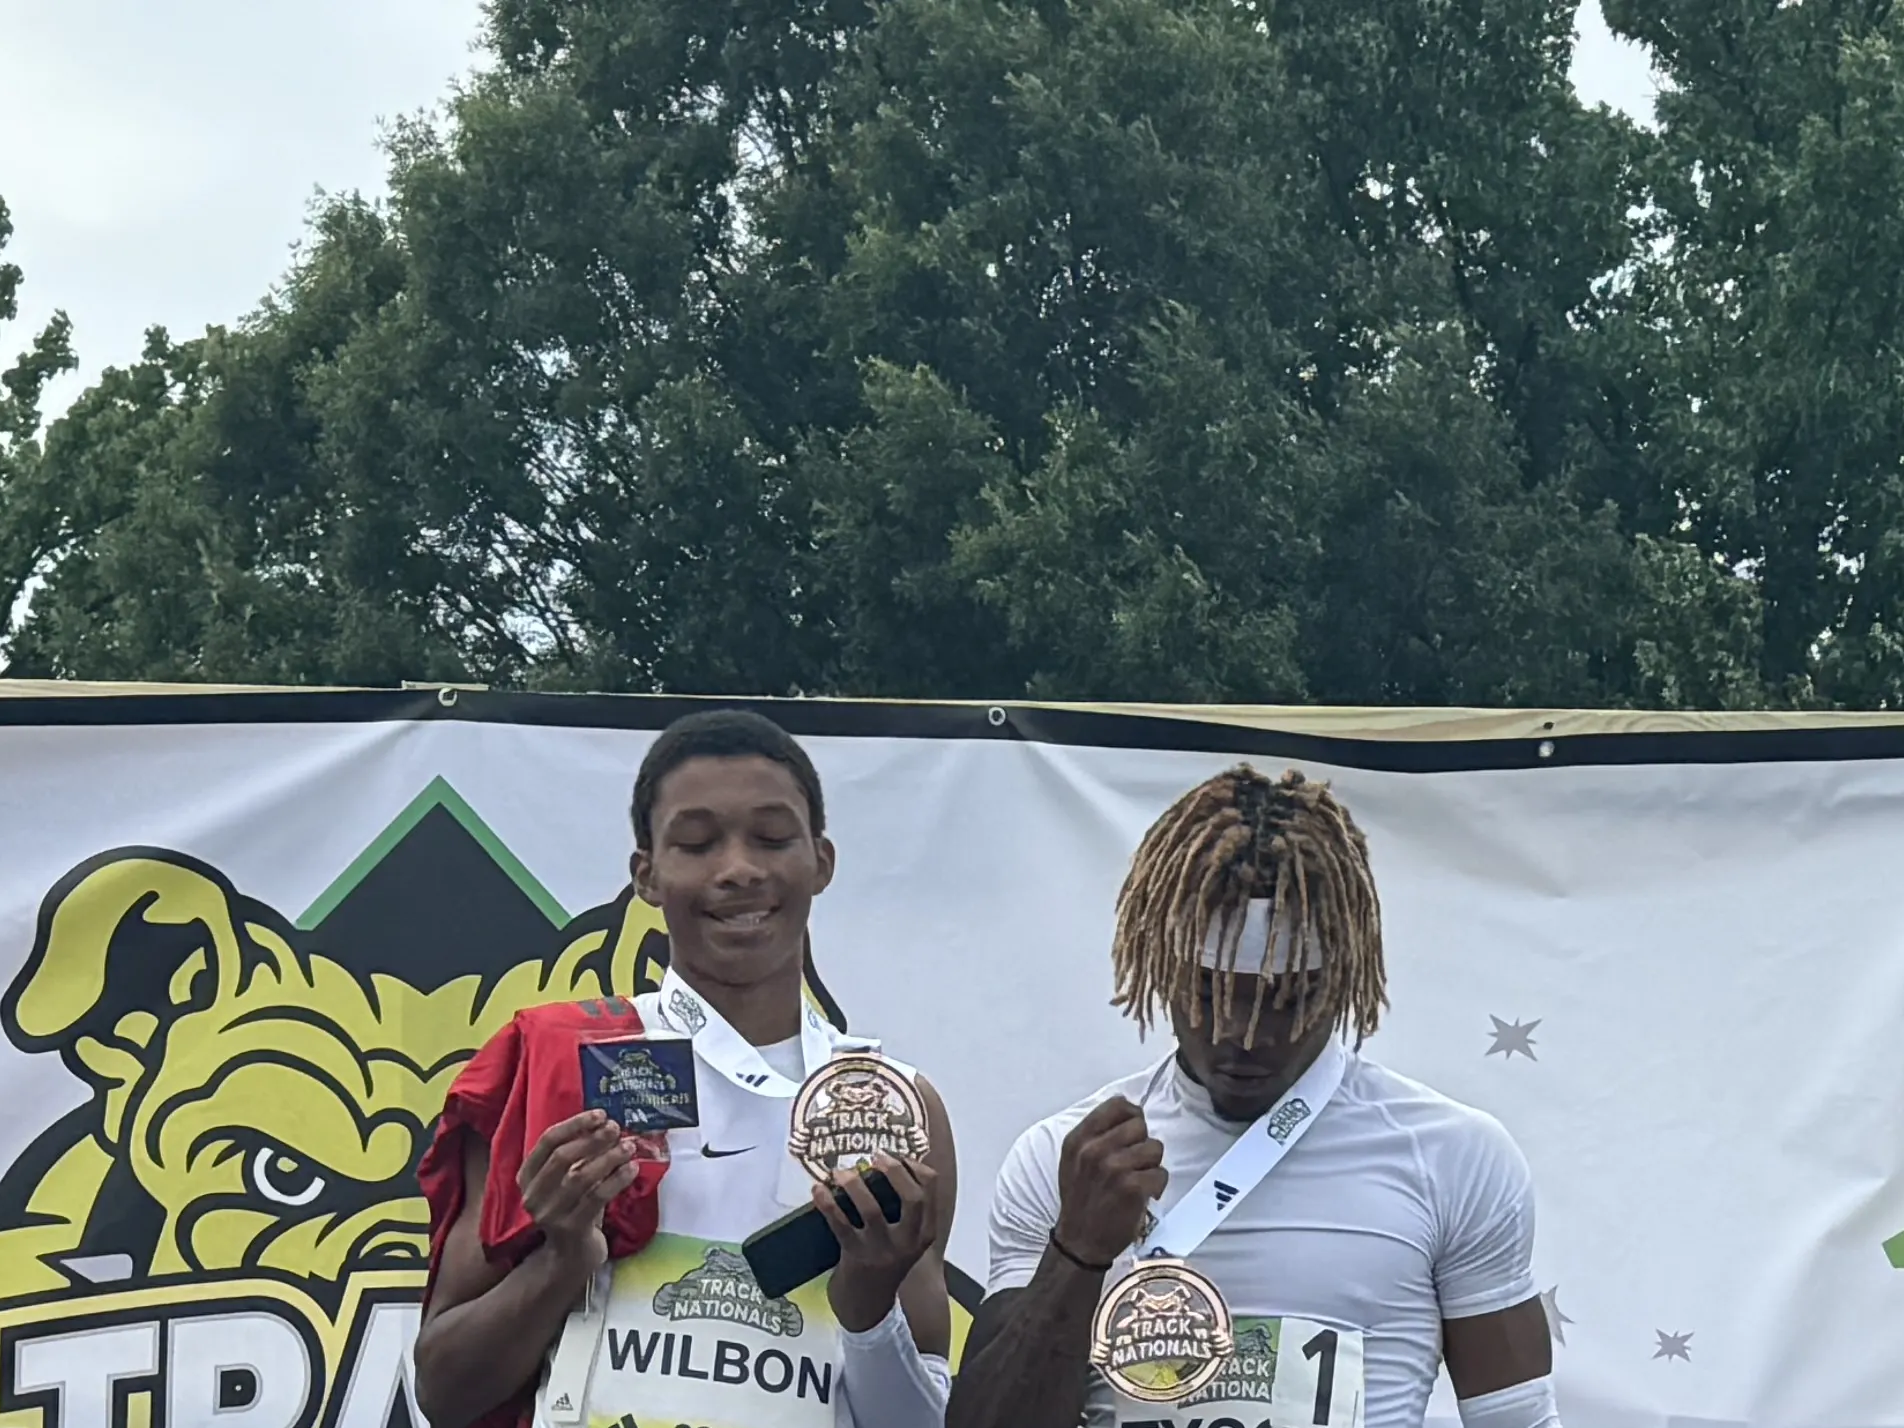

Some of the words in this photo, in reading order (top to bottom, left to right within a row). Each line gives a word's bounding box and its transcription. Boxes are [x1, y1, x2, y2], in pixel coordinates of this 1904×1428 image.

[830, 1110, 890, 1131] TRACK
[809, 1132, 911, 1157] NATIONALS
[673, 1300, 783, 1335] NATIONALS
[1131, 1316, 1192, 1339] TRACK
[1111, 1339, 1213, 1366] NATIONALS
[607, 1327, 833, 1405] WILBON
[1220, 1357, 1271, 1377] ACK
[1301, 1328, 1339, 1427] 1
